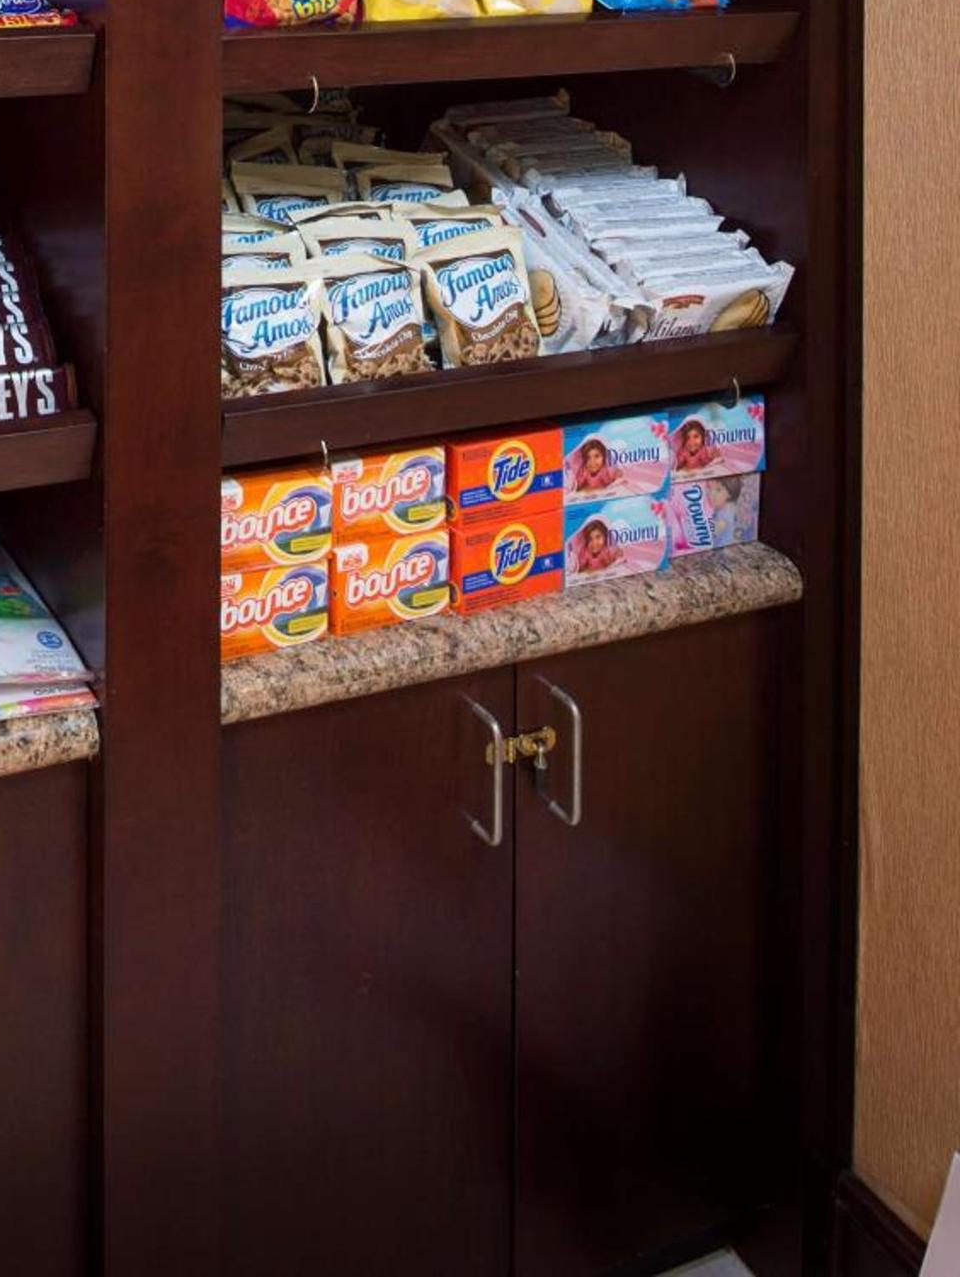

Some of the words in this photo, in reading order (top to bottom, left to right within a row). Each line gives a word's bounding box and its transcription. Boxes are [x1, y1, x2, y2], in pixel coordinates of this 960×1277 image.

[328, 270, 411, 325] Famous
[437, 253, 515, 308] Famous
[470, 280, 520, 322] Amos
[241, 317, 314, 353] Amos
[360, 294, 415, 340] Amos
[607, 444, 662, 468] Downy
[704, 425, 757, 448] Downy
[343, 467, 429, 517] bounce
[493, 454, 531, 493] Tide
[222, 496, 315, 547] bounce
[608, 522, 661, 548] Downy
[683, 484, 713, 549] Downy
[347, 552, 434, 605] bounce
[495, 538, 532, 577] Tide
[222, 577, 311, 631] bounce
